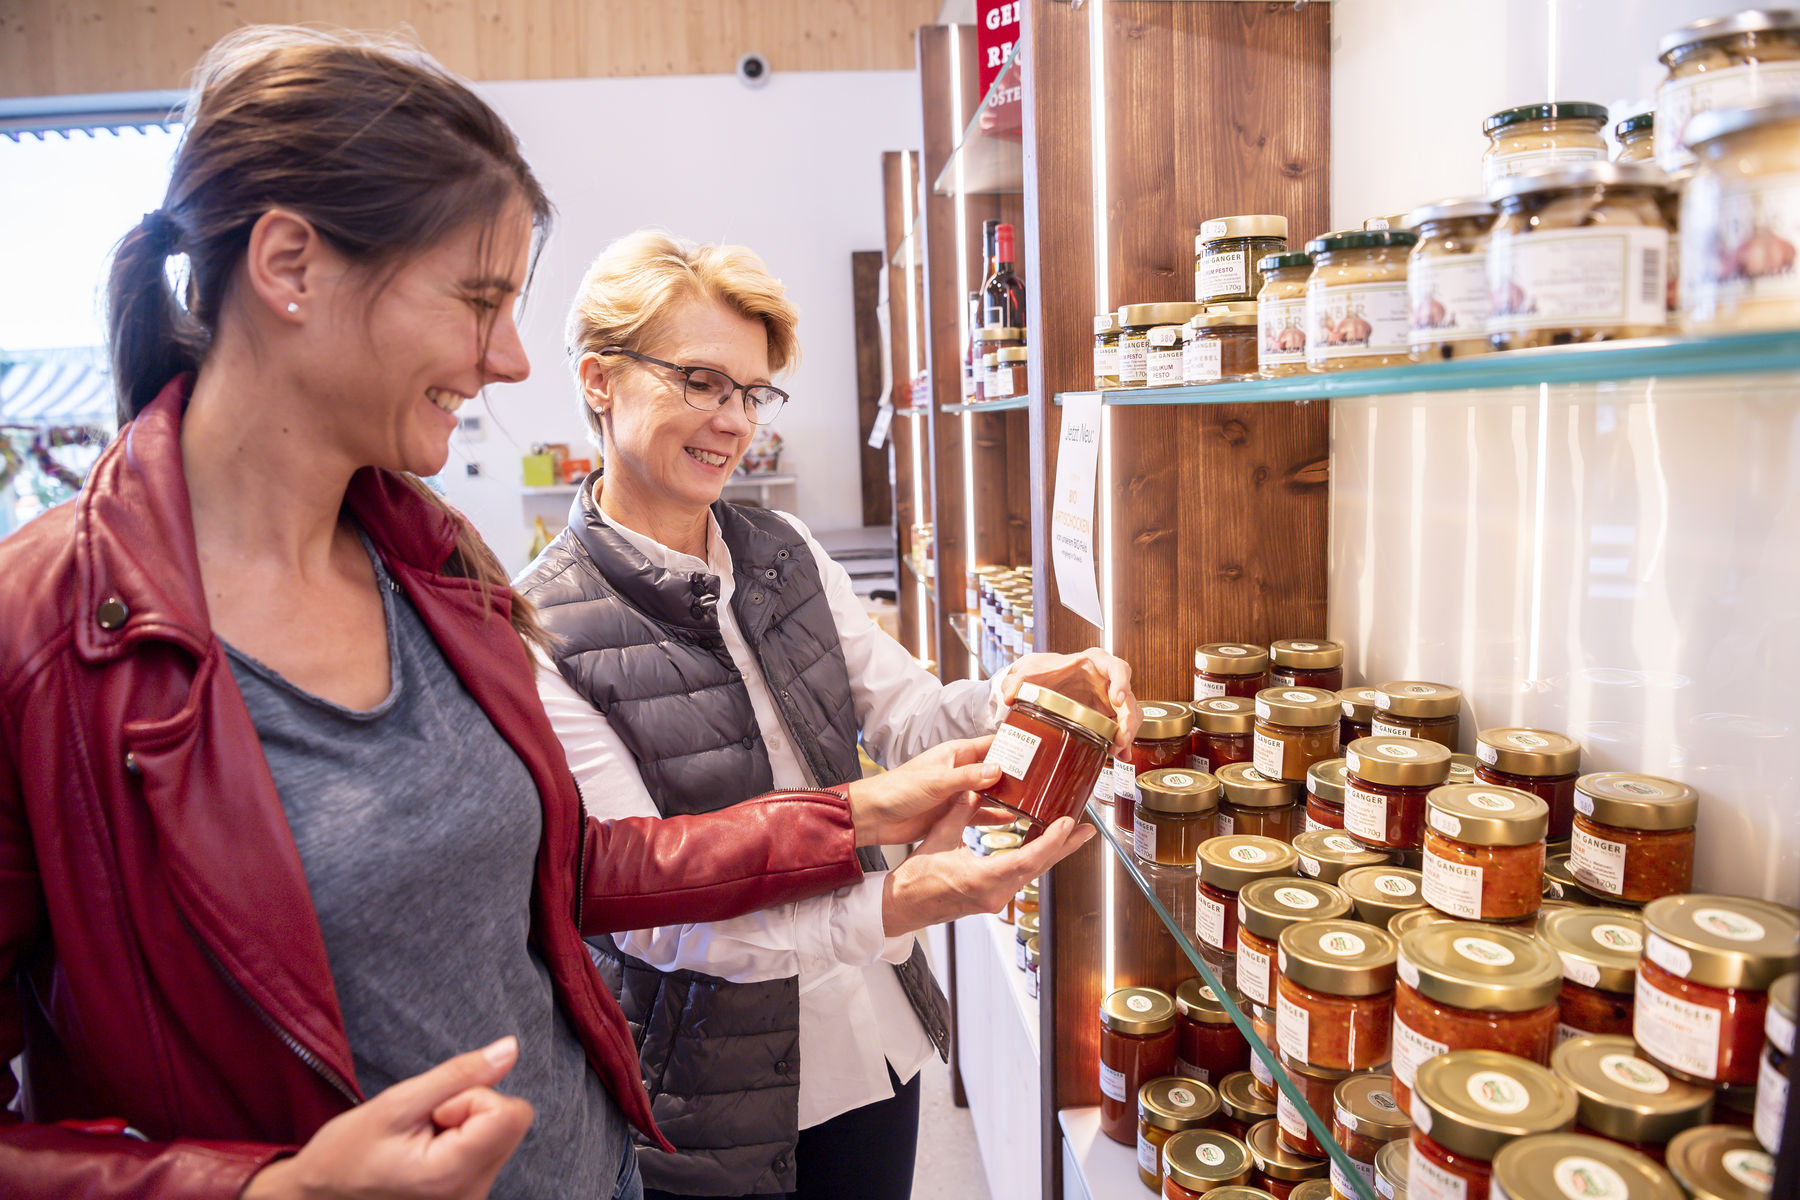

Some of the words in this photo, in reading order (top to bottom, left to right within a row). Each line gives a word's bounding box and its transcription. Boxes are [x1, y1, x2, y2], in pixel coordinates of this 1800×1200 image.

[1211, 253, 1241, 264] GANGER
[1379, 725, 1407, 736] GANGER
[1007, 729, 1036, 746] GANGER
[1257, 734, 1281, 748] GANGER
[1352, 790, 1383, 805] GANGER
[1363, 826, 1381, 839] 170g
[1582, 835, 1621, 854] GANGER
[1437, 860, 1477, 878] GANGER
[1595, 878, 1617, 891] 170g
[1453, 903, 1475, 915] 170g
